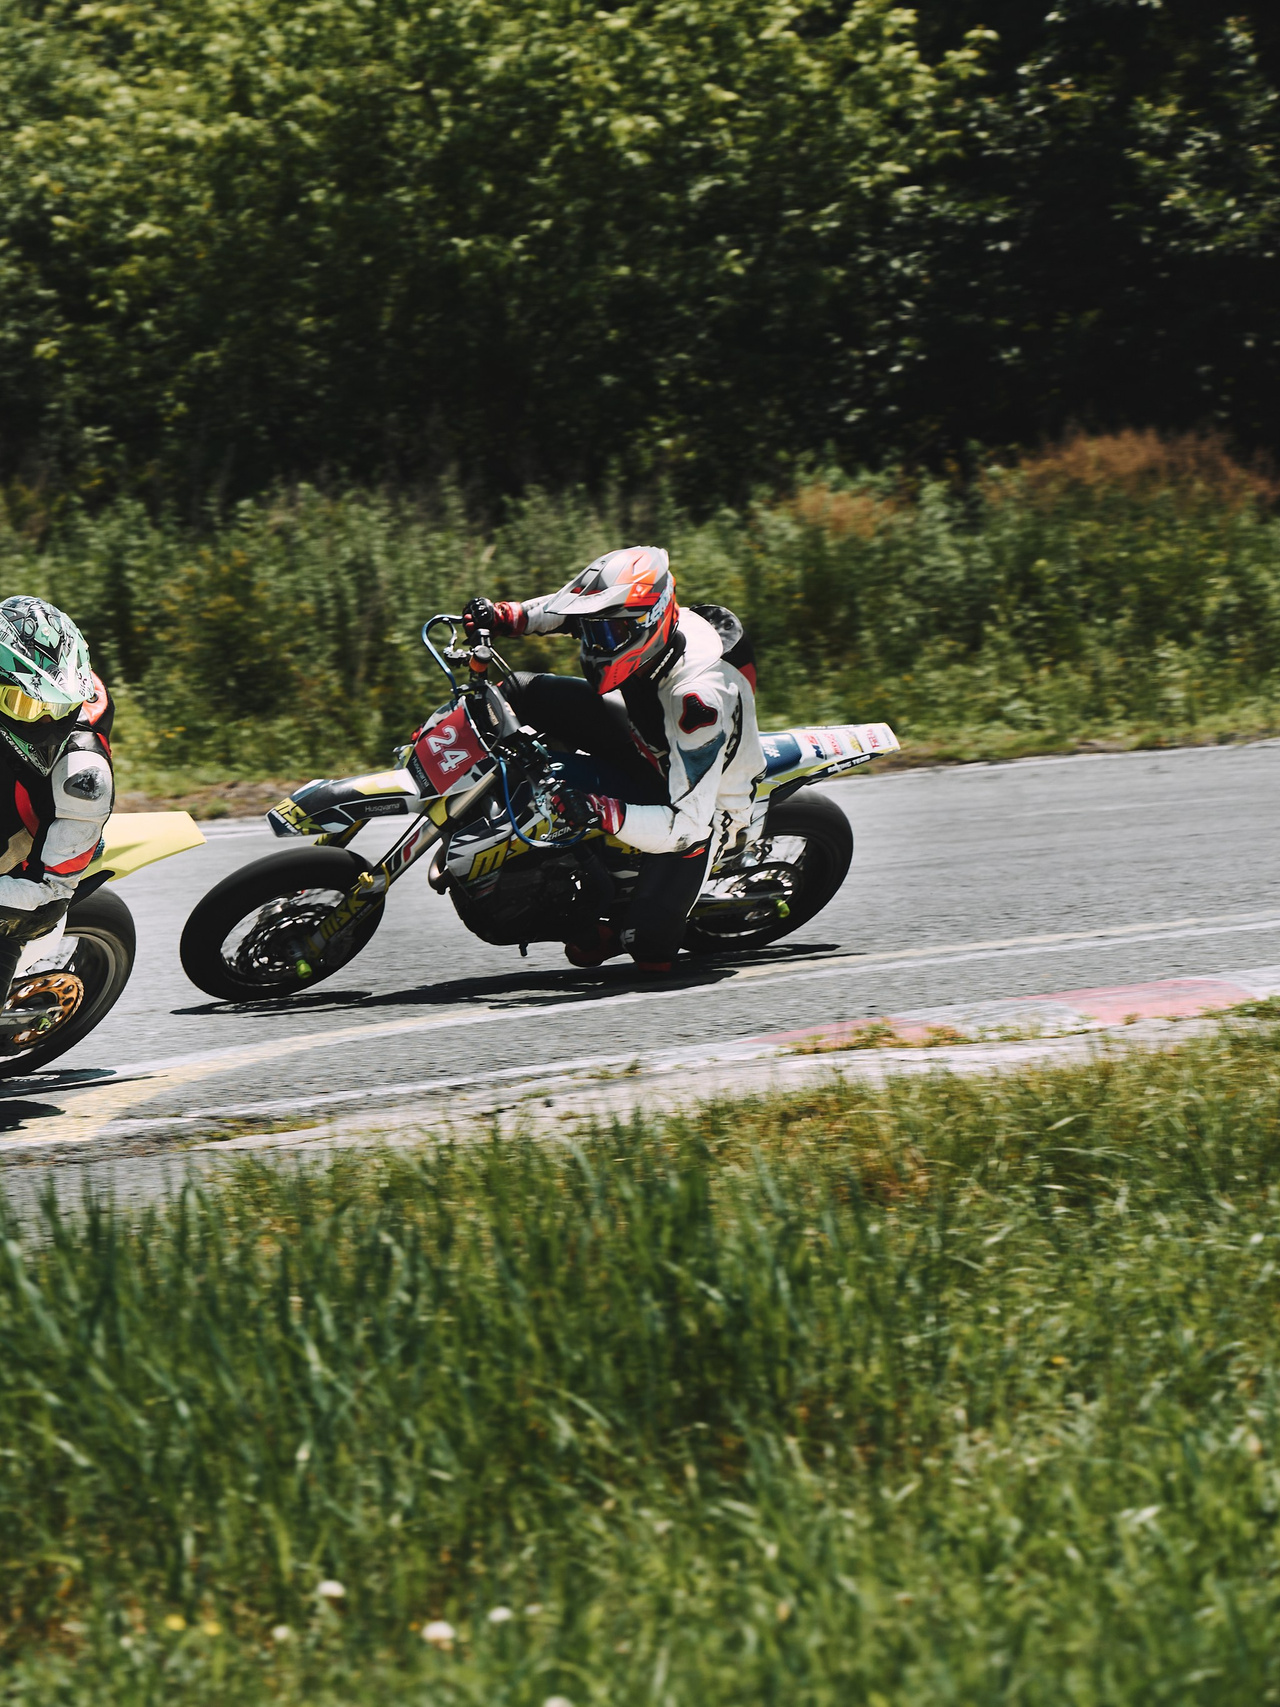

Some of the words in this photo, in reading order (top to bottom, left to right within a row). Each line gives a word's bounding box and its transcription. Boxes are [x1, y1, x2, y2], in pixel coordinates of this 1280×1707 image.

[0, 729, 28, 761] ACERBIS
[425, 725, 471, 775] 24
[412, 756, 430, 788] Husqvarna
[365, 803, 400, 813] Husqvarna
[321, 891, 368, 940] MSK
